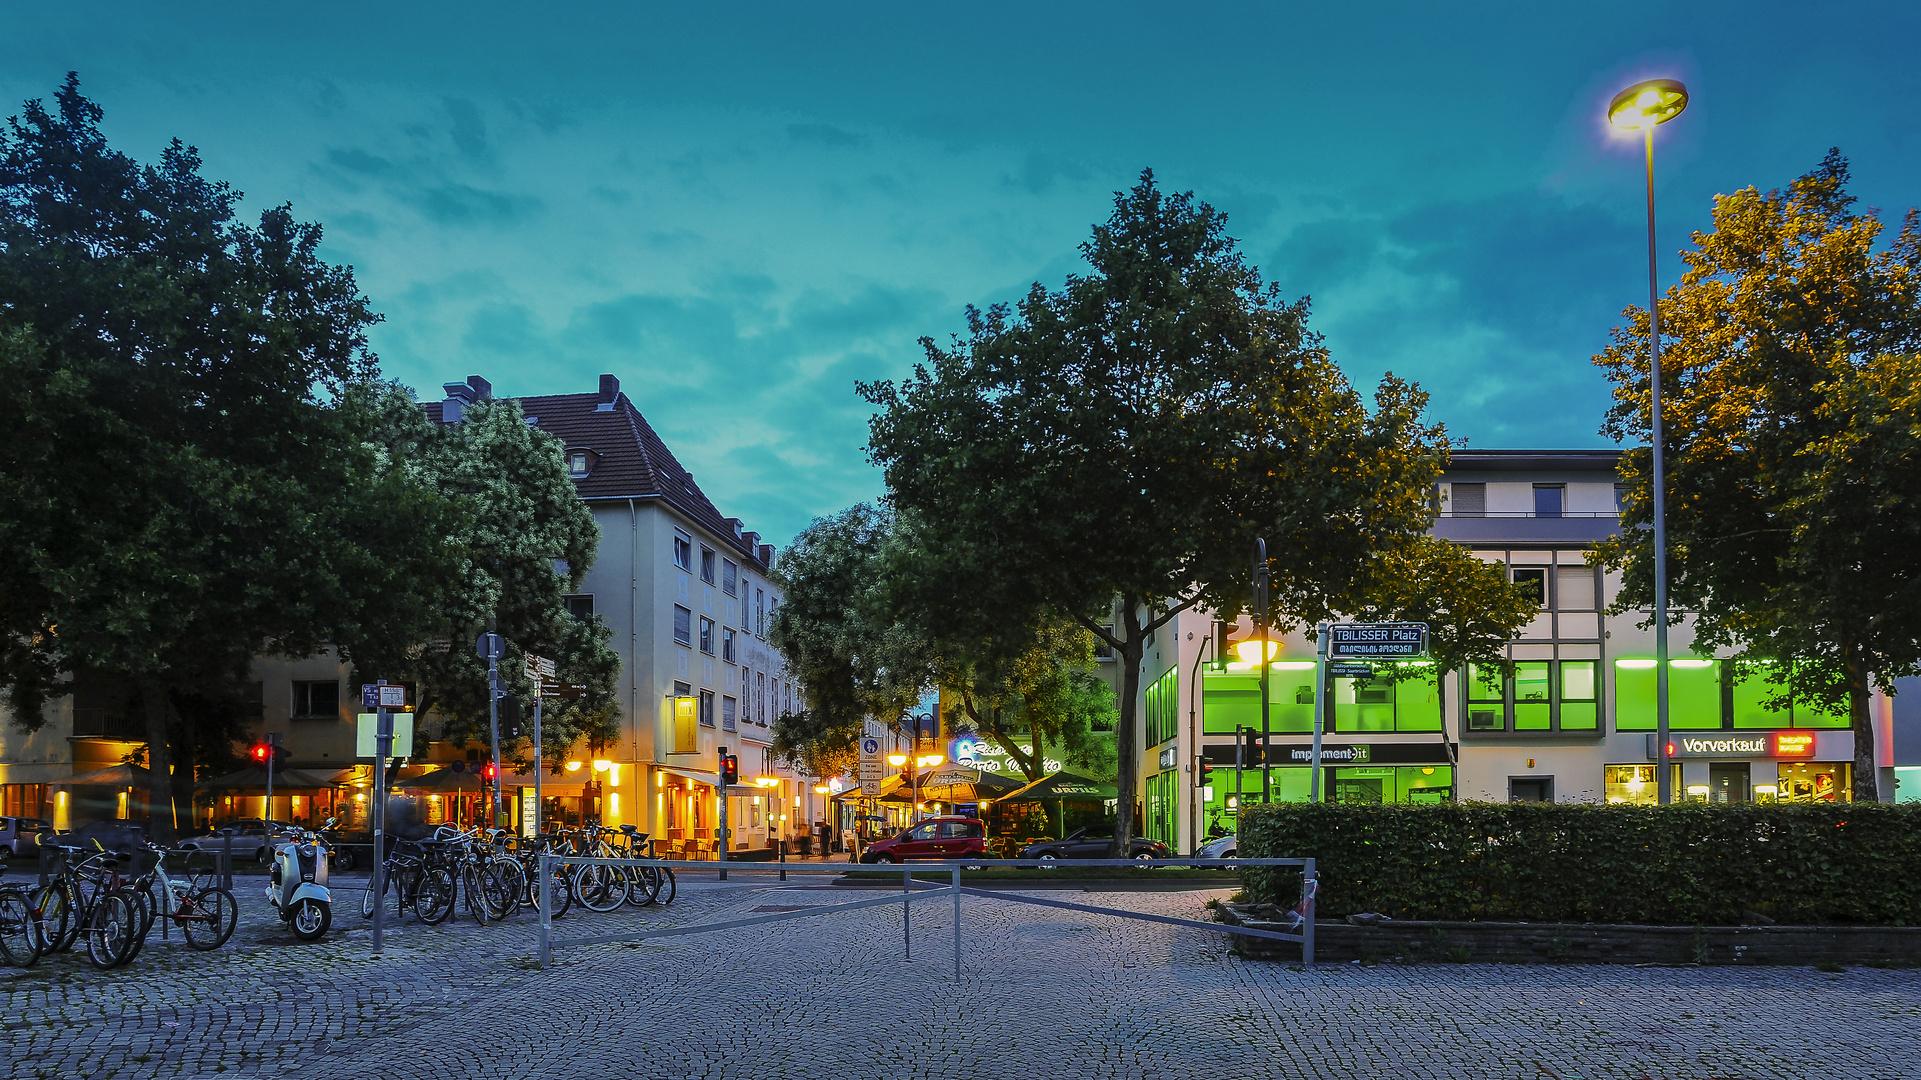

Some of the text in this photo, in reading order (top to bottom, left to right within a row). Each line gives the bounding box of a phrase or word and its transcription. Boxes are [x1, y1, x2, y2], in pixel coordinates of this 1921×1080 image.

[1336, 630, 1417, 640] TBILISSER Platz
[1683, 737, 1766, 752] Vorverkauf
[1779, 736, 1812, 744] THEATER
